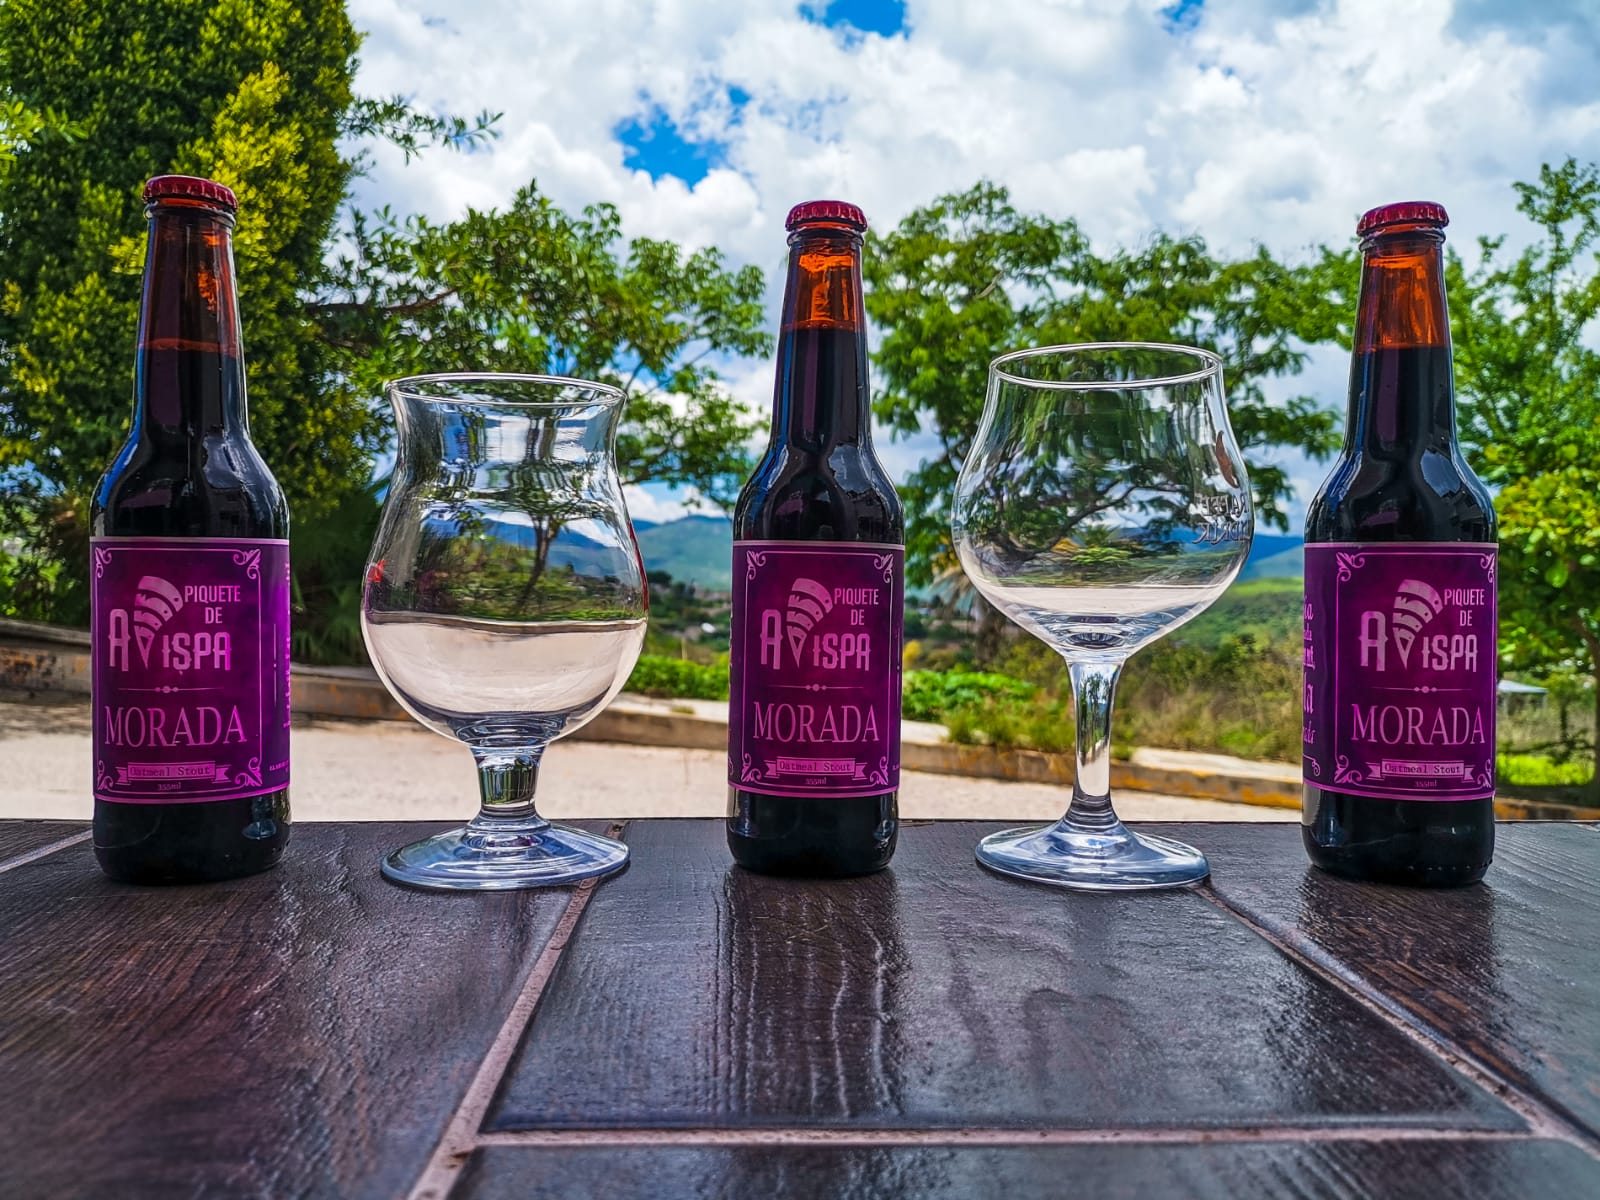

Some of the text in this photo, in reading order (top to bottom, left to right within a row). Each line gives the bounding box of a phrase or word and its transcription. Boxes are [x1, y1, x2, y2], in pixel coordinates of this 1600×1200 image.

[184, 585, 241, 603] PIQUETE
[834, 588, 879, 605] PIQUETE
[1444, 589, 1485, 606] PIQUETE
[205, 607, 223, 624] DE
[850, 609, 865, 626] DE
[1459, 610, 1472, 626] DE
[108, 608, 232, 671] AVISPA
[760, 609, 871, 671] AVISPA
[1358, 610, 1478, 672] AVISPA
[104, 705, 247, 747] MORADA
[753, 701, 880, 742] MORADA
[1351, 703, 1486, 745] MORADA
[129, 766, 210, 777] Oatmeal Stout
[779, 761, 851, 771] Oatmeal Stout
[1384, 763, 1461, 774] Oatmeal Stout
